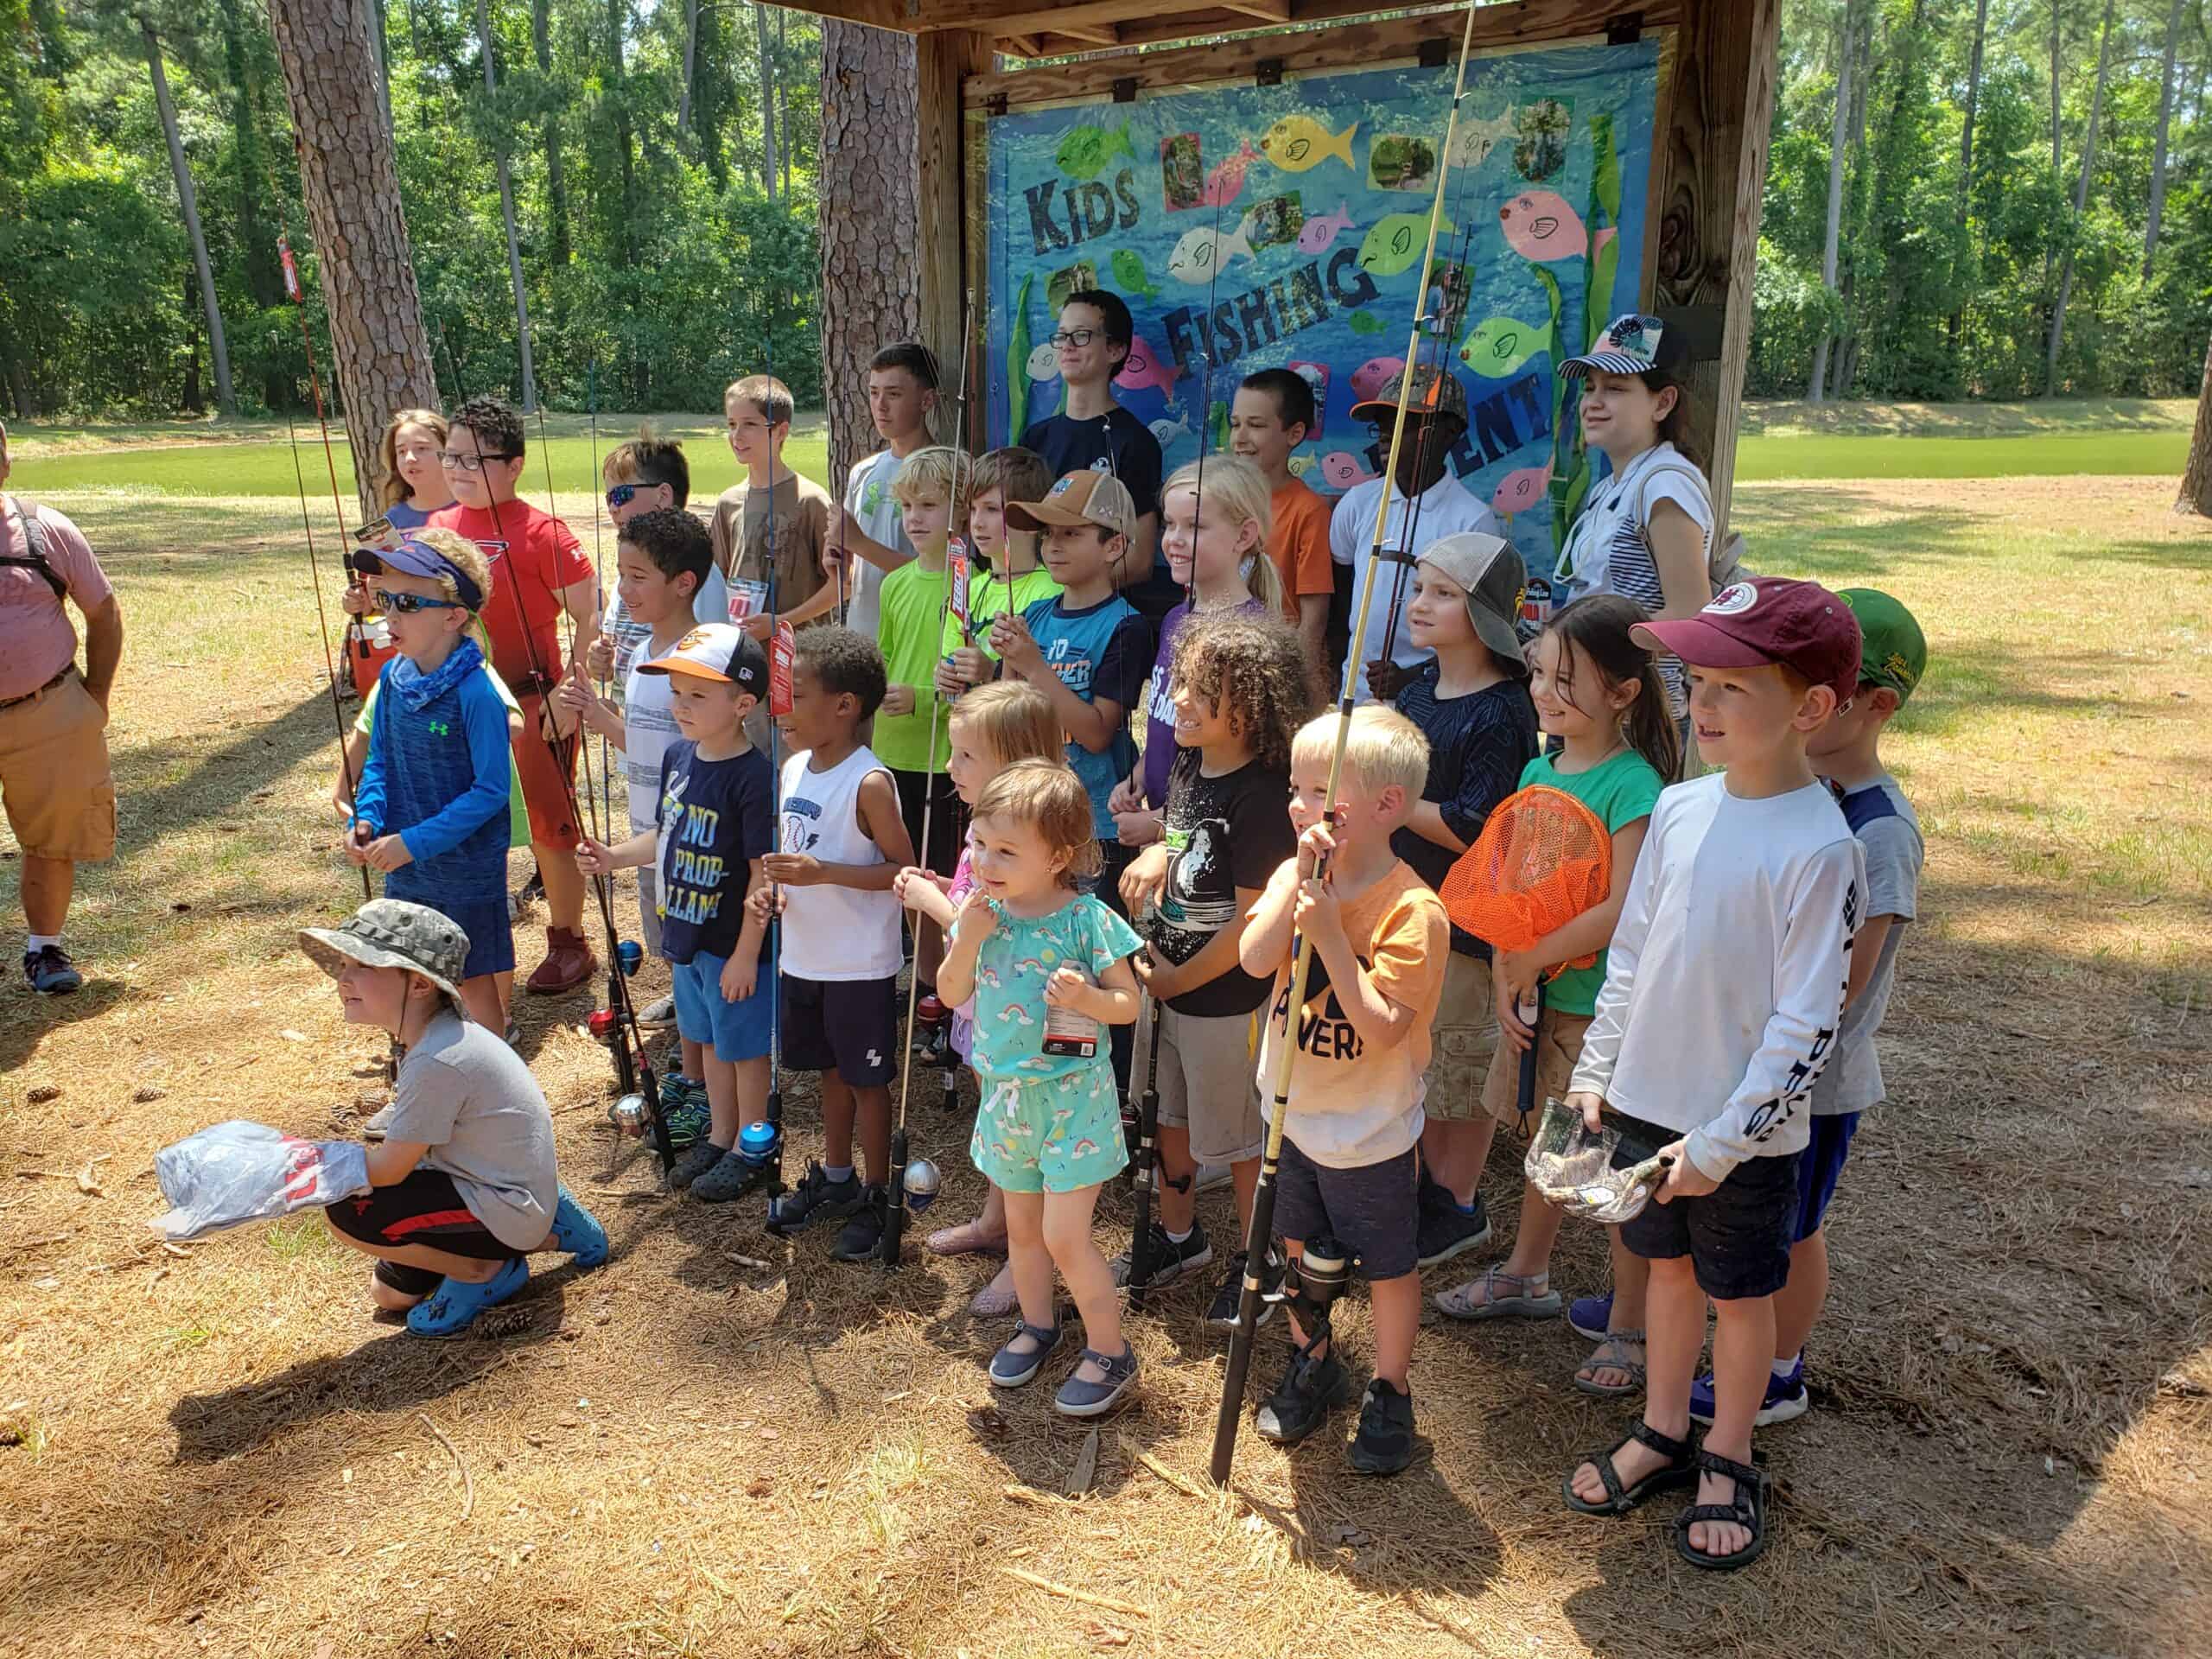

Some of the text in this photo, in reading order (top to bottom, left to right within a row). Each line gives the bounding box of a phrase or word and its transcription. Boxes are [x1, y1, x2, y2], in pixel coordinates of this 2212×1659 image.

[1023, 167, 1141, 257] KIDS
[1160, 246, 1382, 382] FISHING
[682, 803, 720, 849] NO
